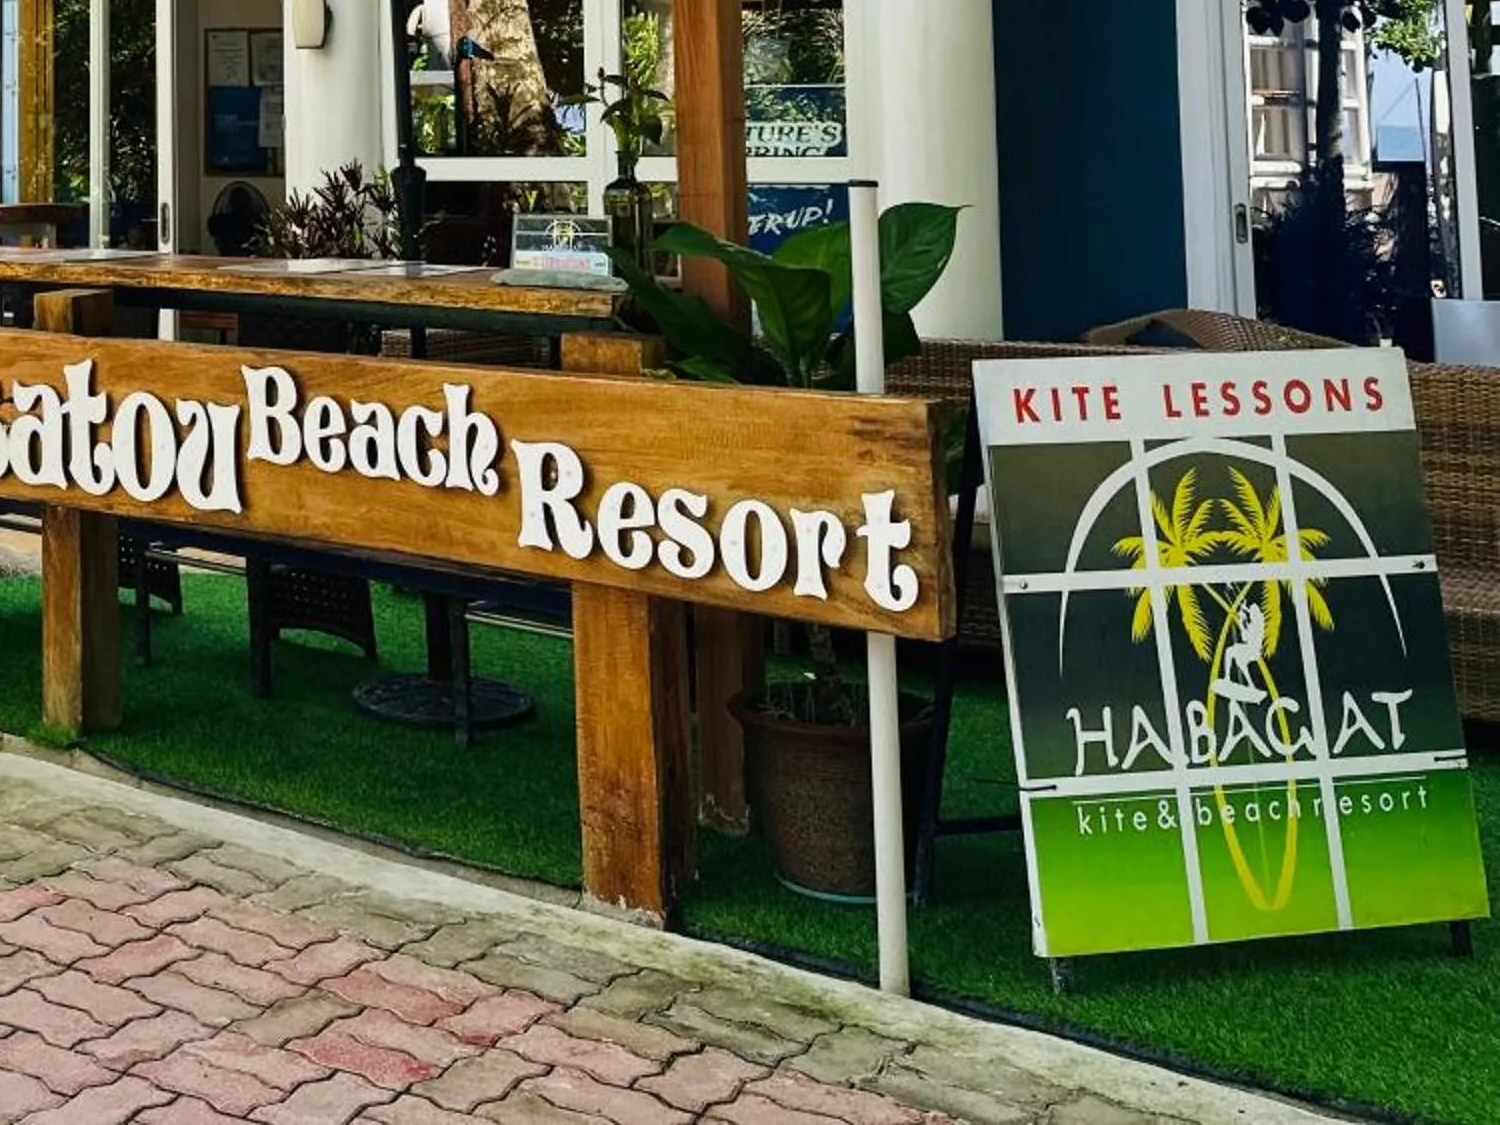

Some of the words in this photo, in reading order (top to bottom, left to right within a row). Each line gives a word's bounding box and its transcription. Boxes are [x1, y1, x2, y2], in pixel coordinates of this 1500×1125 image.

[1013, 385, 1122, 424] KITE
[1164, 377, 1384, 420] LESSONS
[241, 364, 500, 496] Beach
[510, 439, 919, 612] Resort
[1065, 688, 1413, 777] HABAGAT
